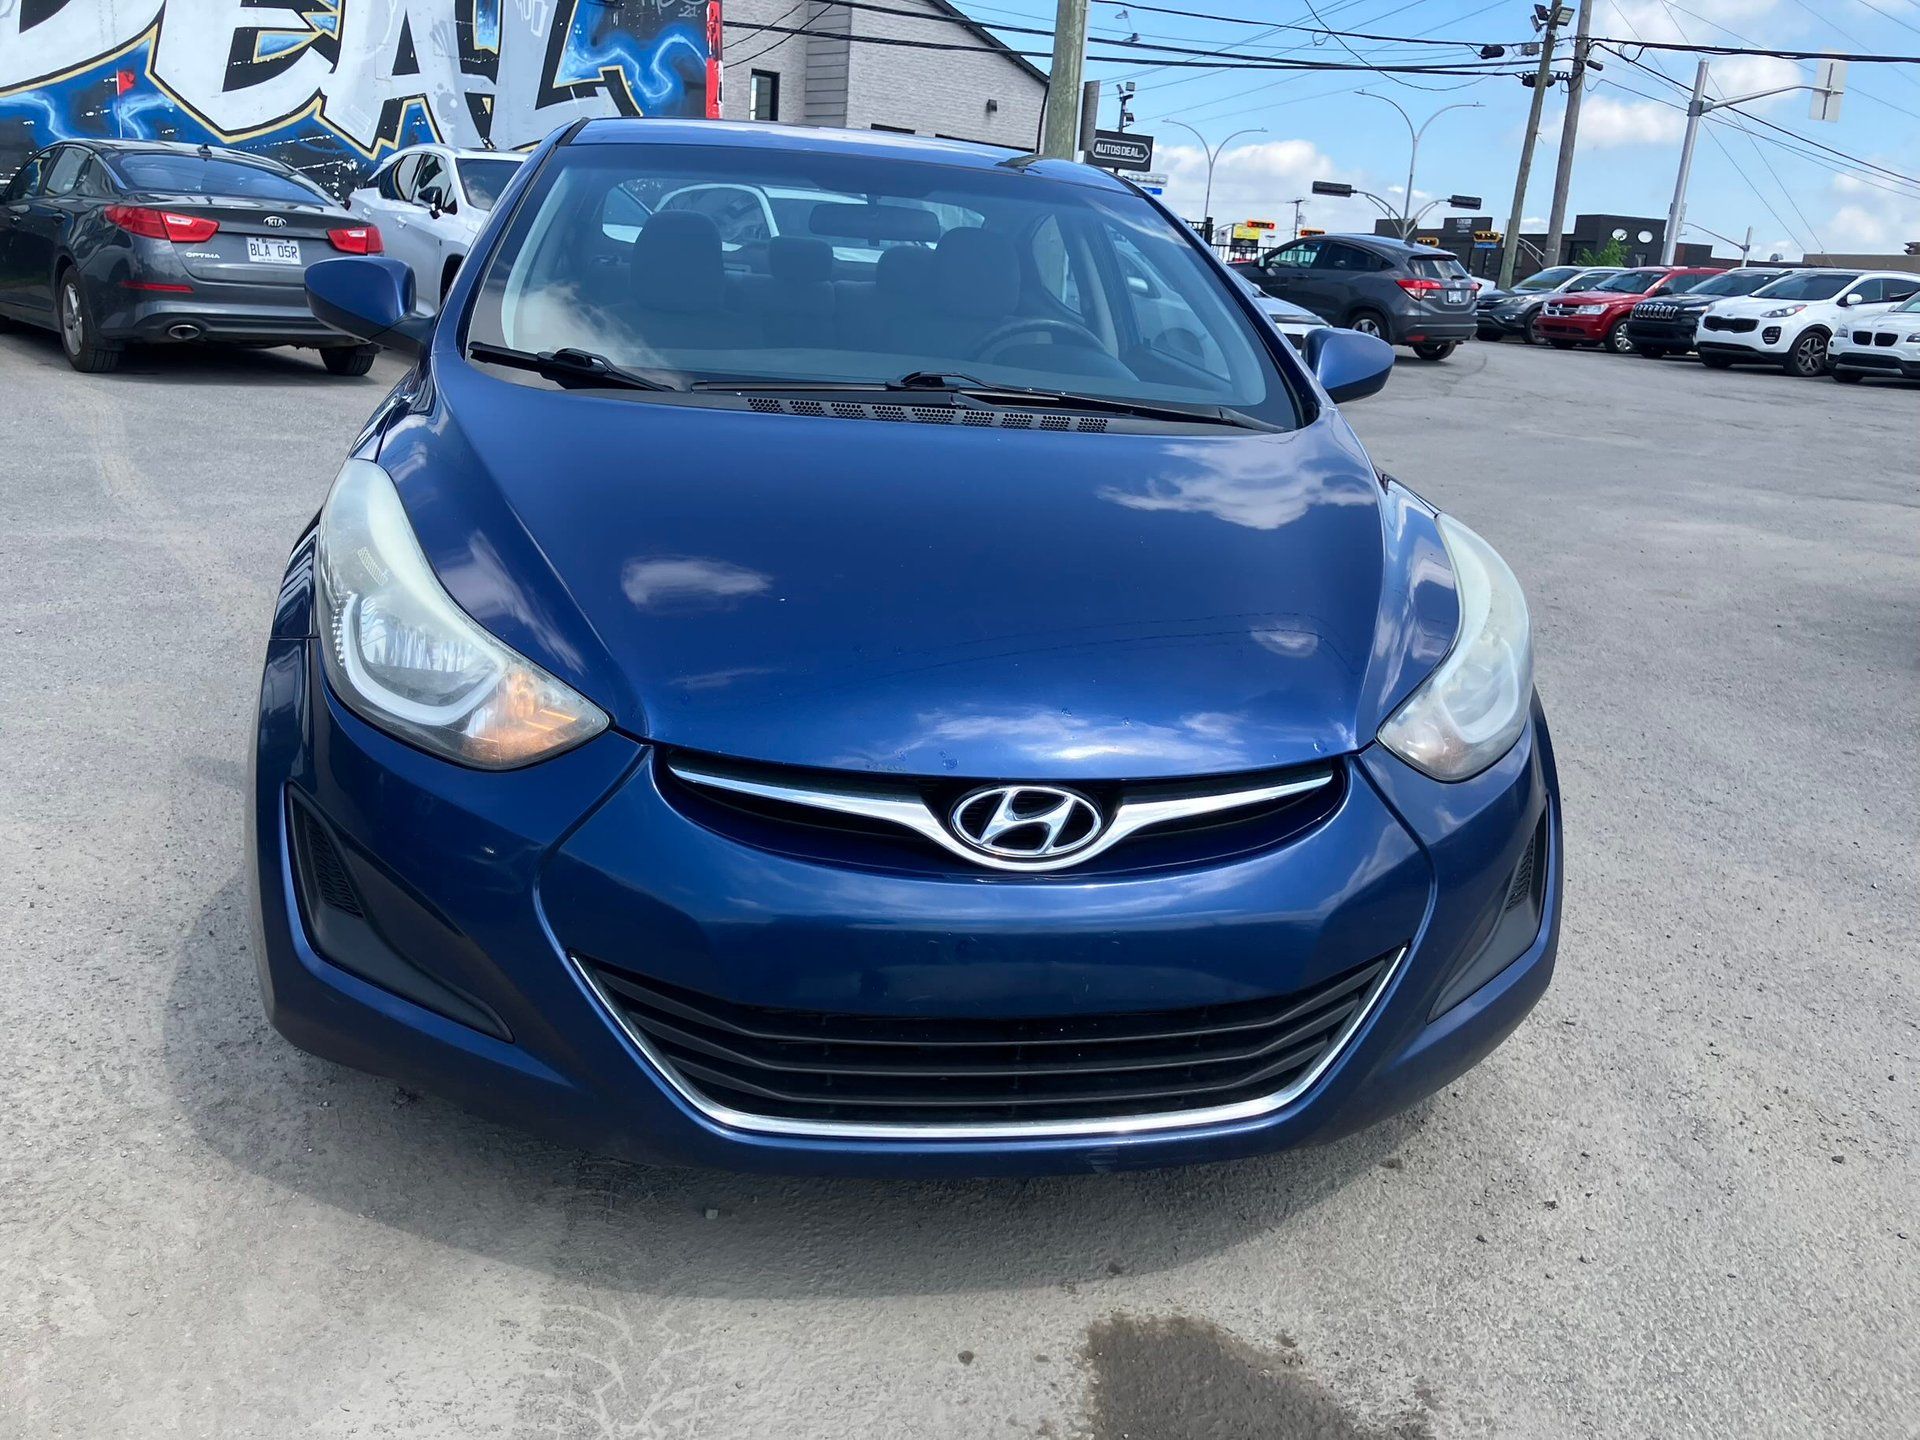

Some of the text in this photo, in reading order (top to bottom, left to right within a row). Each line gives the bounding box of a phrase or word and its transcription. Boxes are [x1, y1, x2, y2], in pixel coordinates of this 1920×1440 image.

[1095, 143, 1120, 156] AUTOS
[267, 217, 284, 227] KIA
[250, 243, 271, 257] BLA
